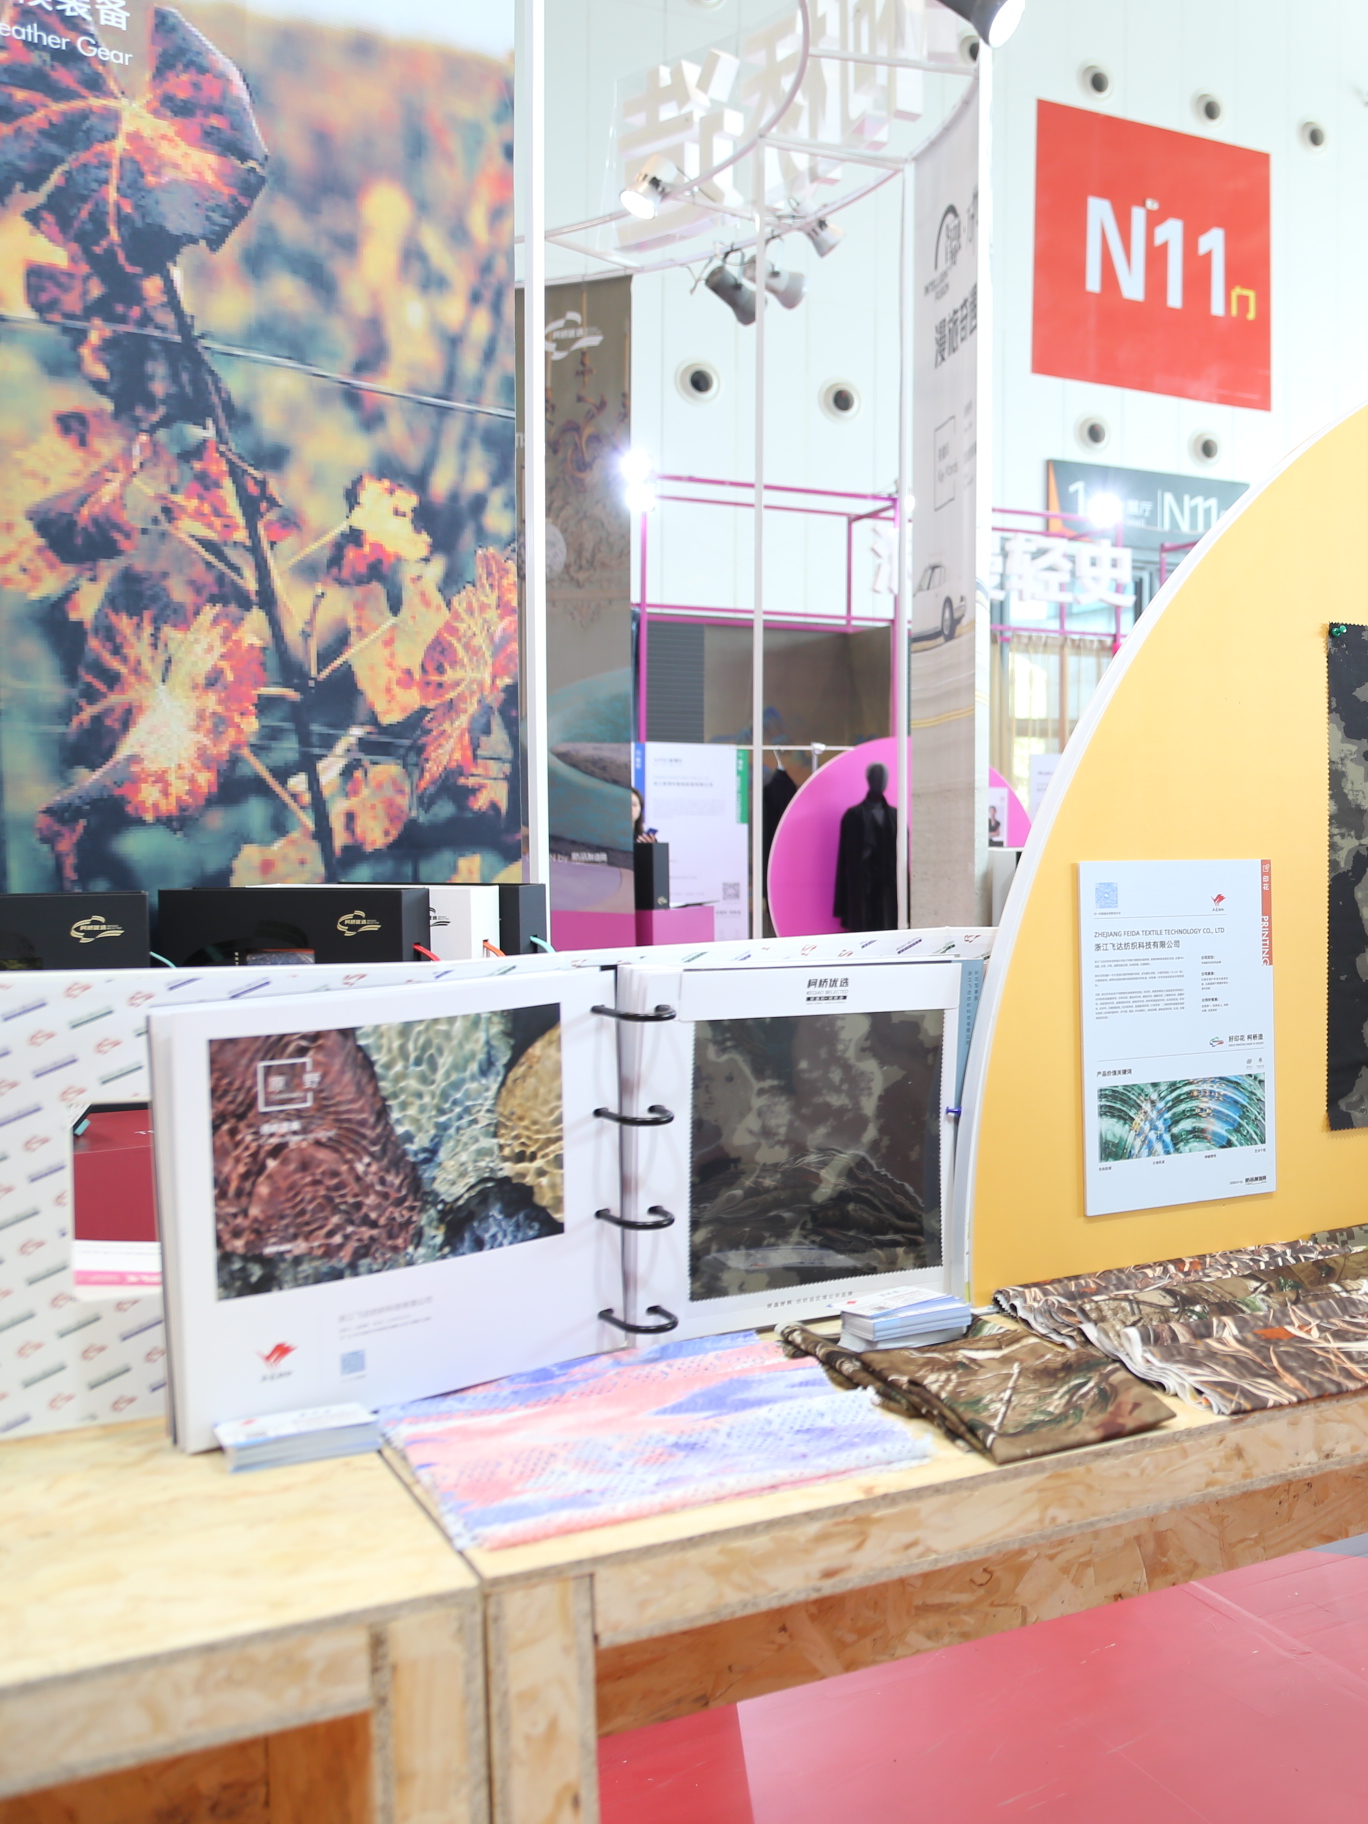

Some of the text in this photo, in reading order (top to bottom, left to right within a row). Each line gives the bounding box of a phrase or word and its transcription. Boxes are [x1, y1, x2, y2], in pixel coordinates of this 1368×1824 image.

[17, 0, 131, 31] 装备
[0, 22, 134, 66] eather Gear
[1163, 491, 1222, 532] N11
[1262, 875, 1270, 891] 印花
[1094, 931, 1122, 939] ZHEJIANG
[1123, 930, 1140, 938] FEIDA
[1141, 929, 1163, 937] TEXTILE
[1164, 928, 1201, 936] TECHNOLOGY
[1261, 915, 1271, 966] PRINTING
[1094, 940, 1181, 952] 浙江飞达纺织科技有限公司
[806, 977, 849, 989] 柯桥优选
[1228, 1033, 1264, 1043] 好印花 柯桥造
[1096, 1068, 1133, 1078] 产品价值关键词
